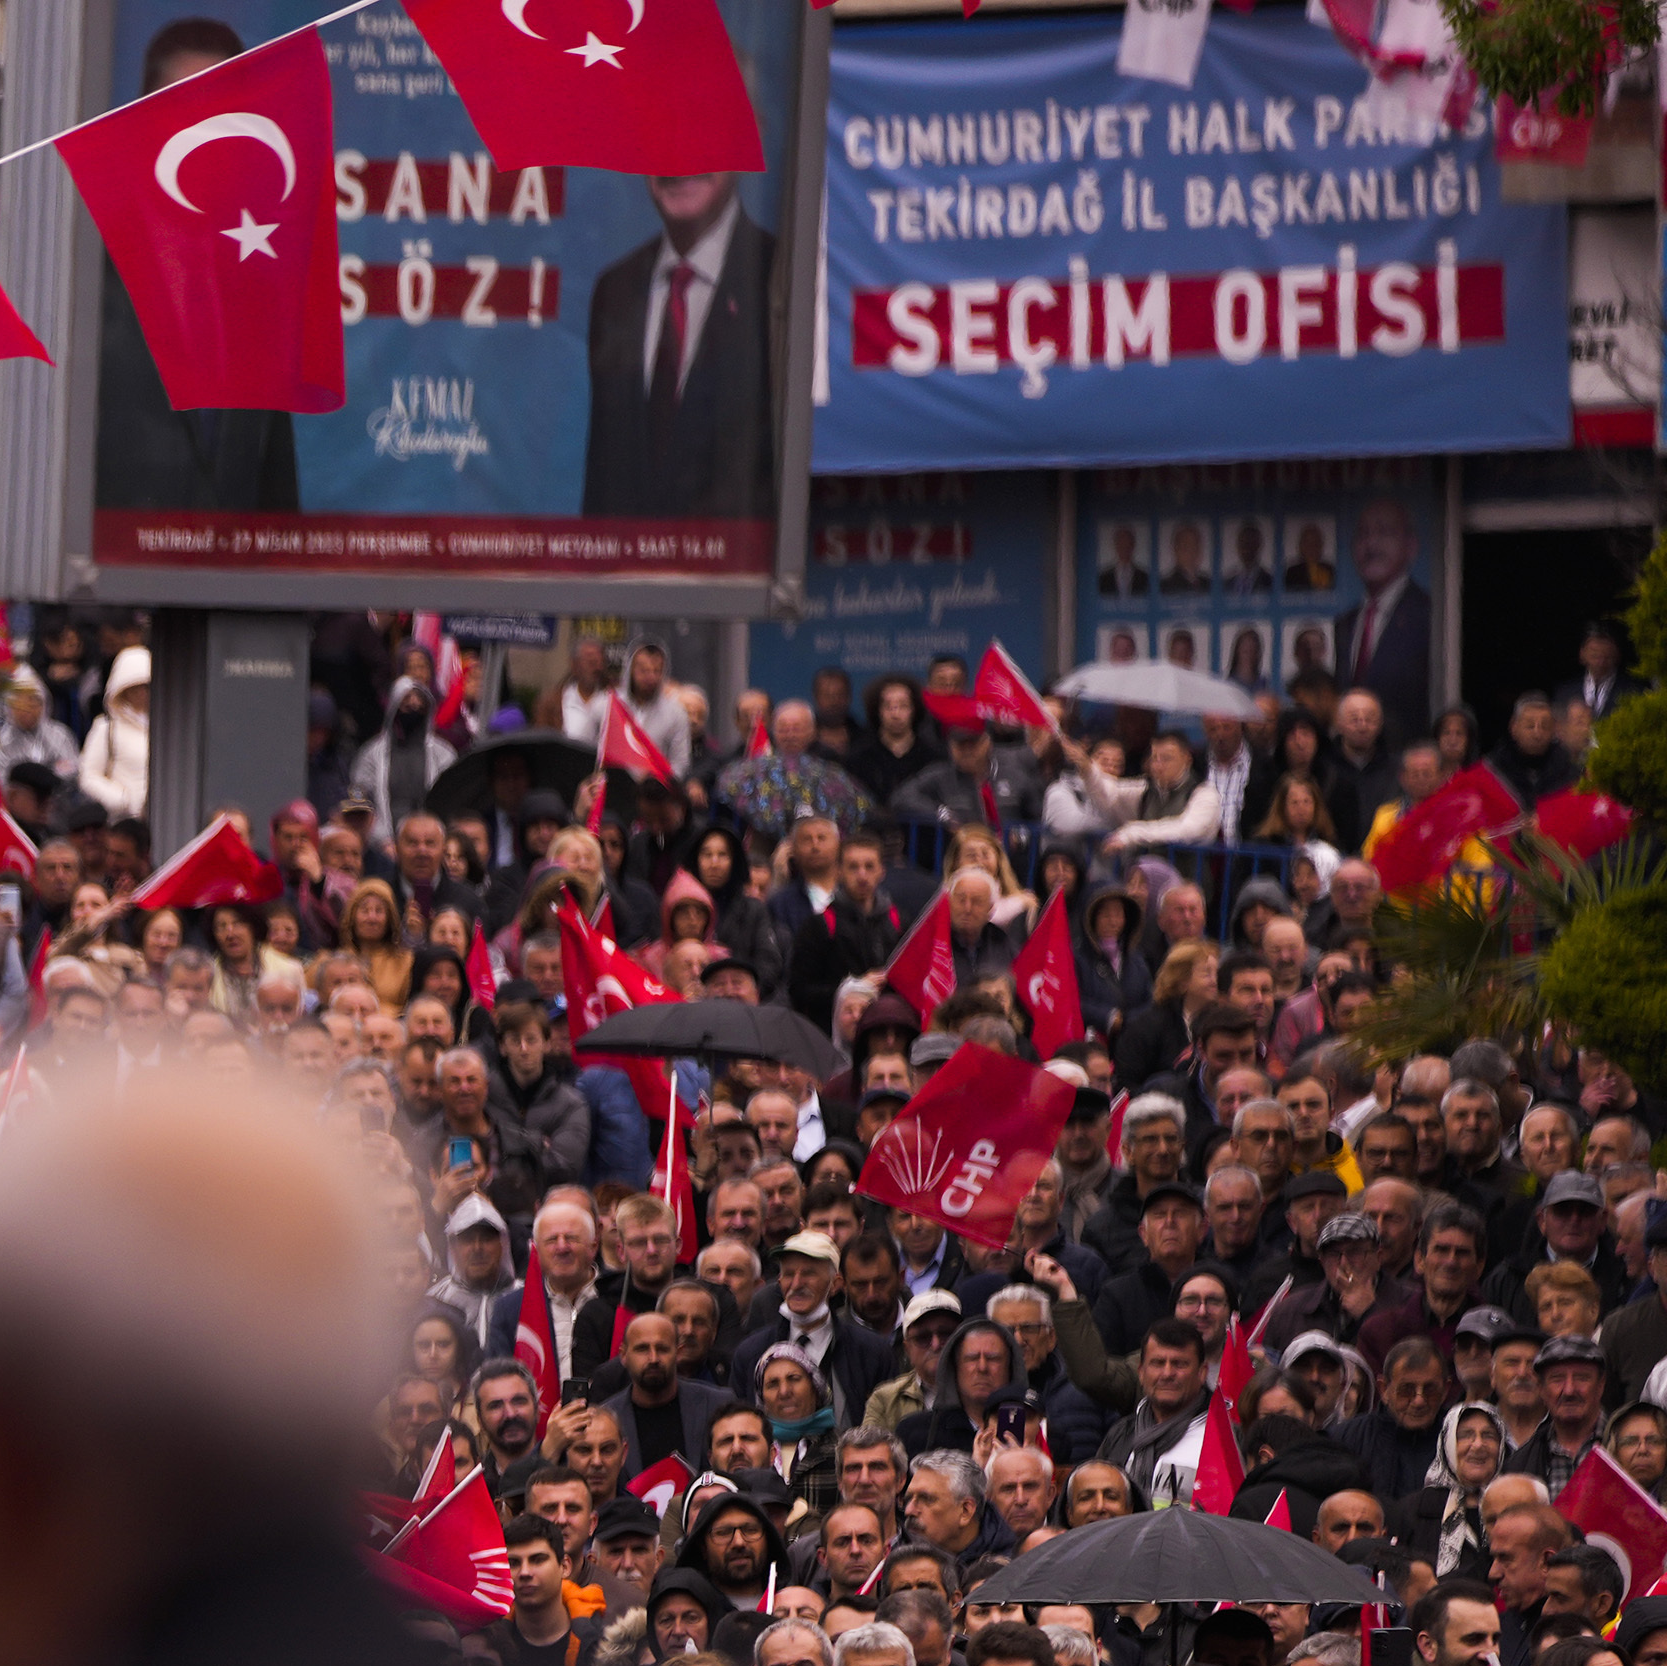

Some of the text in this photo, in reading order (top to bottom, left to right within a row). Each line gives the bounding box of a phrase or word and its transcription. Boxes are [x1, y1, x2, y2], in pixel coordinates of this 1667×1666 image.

[844, 97, 1151, 169] CUMHURİYET
[1169, 97, 1296, 156] HALK
[334, 149, 552, 227] SANA
[869, 152, 1481, 243] TEKİRDAĞ İL BAŞKANLIĞI
[338, 237, 548, 331] SÖZ!
[886, 237, 1460, 399] SEÇİM OFİSİ
[939, 1137, 1001, 1219] CHP
